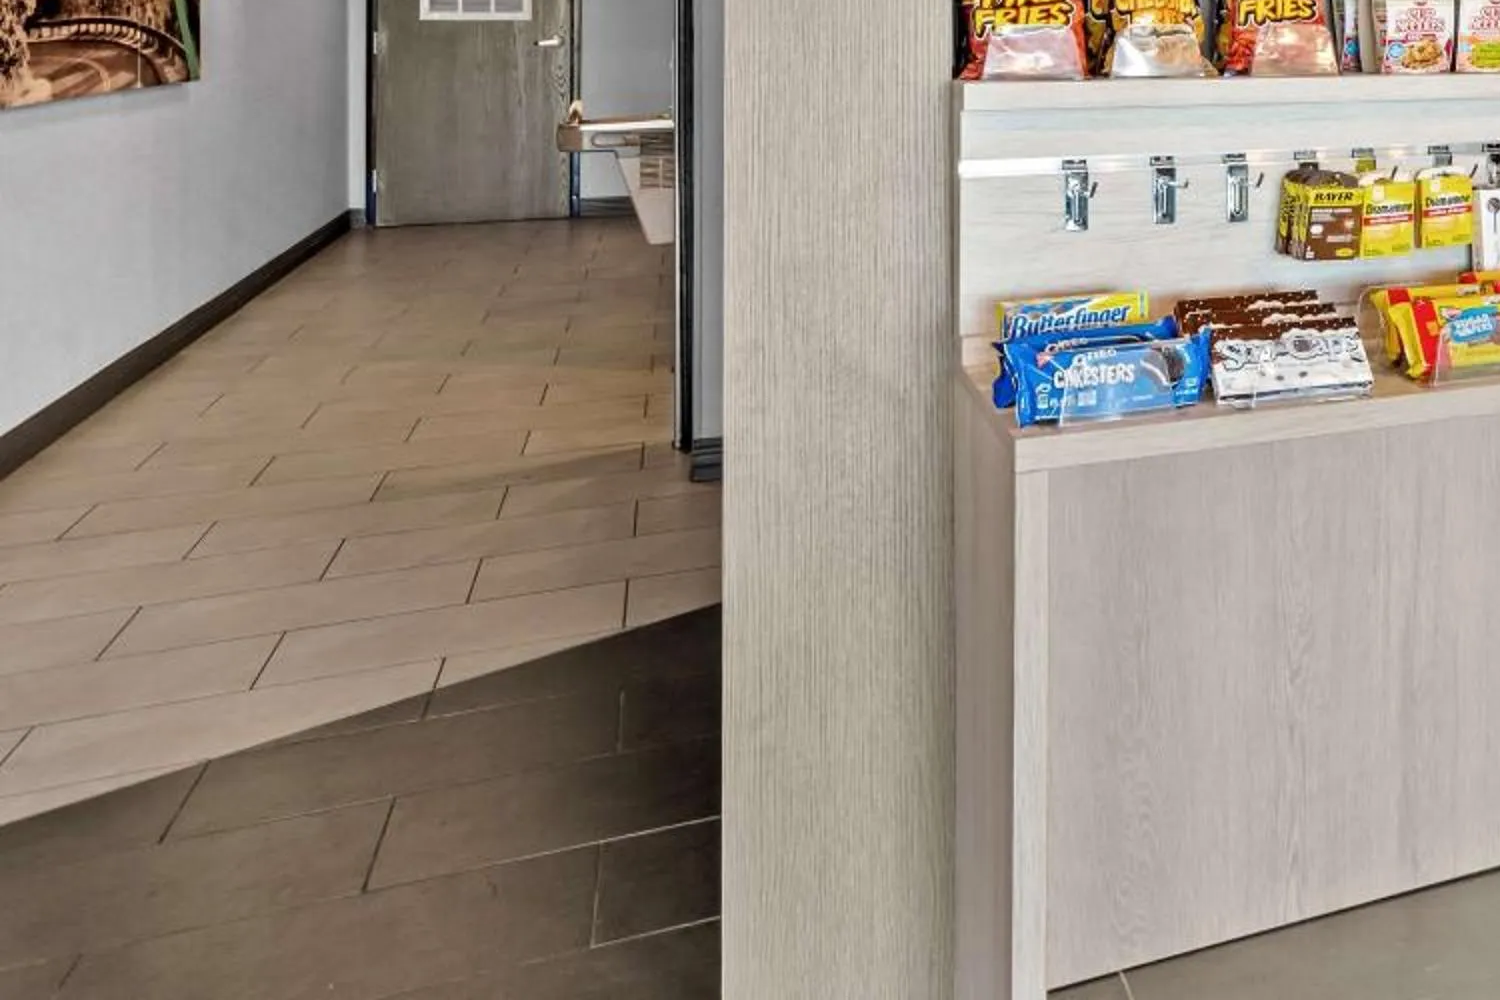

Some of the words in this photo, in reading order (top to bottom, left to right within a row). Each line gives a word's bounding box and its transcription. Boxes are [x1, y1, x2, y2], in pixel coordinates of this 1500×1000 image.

[973, 2, 1074, 38] FRIES
[1010, 305, 1131, 339] Butterfinger
[1053, 363, 1135, 389] CAKESTERS
